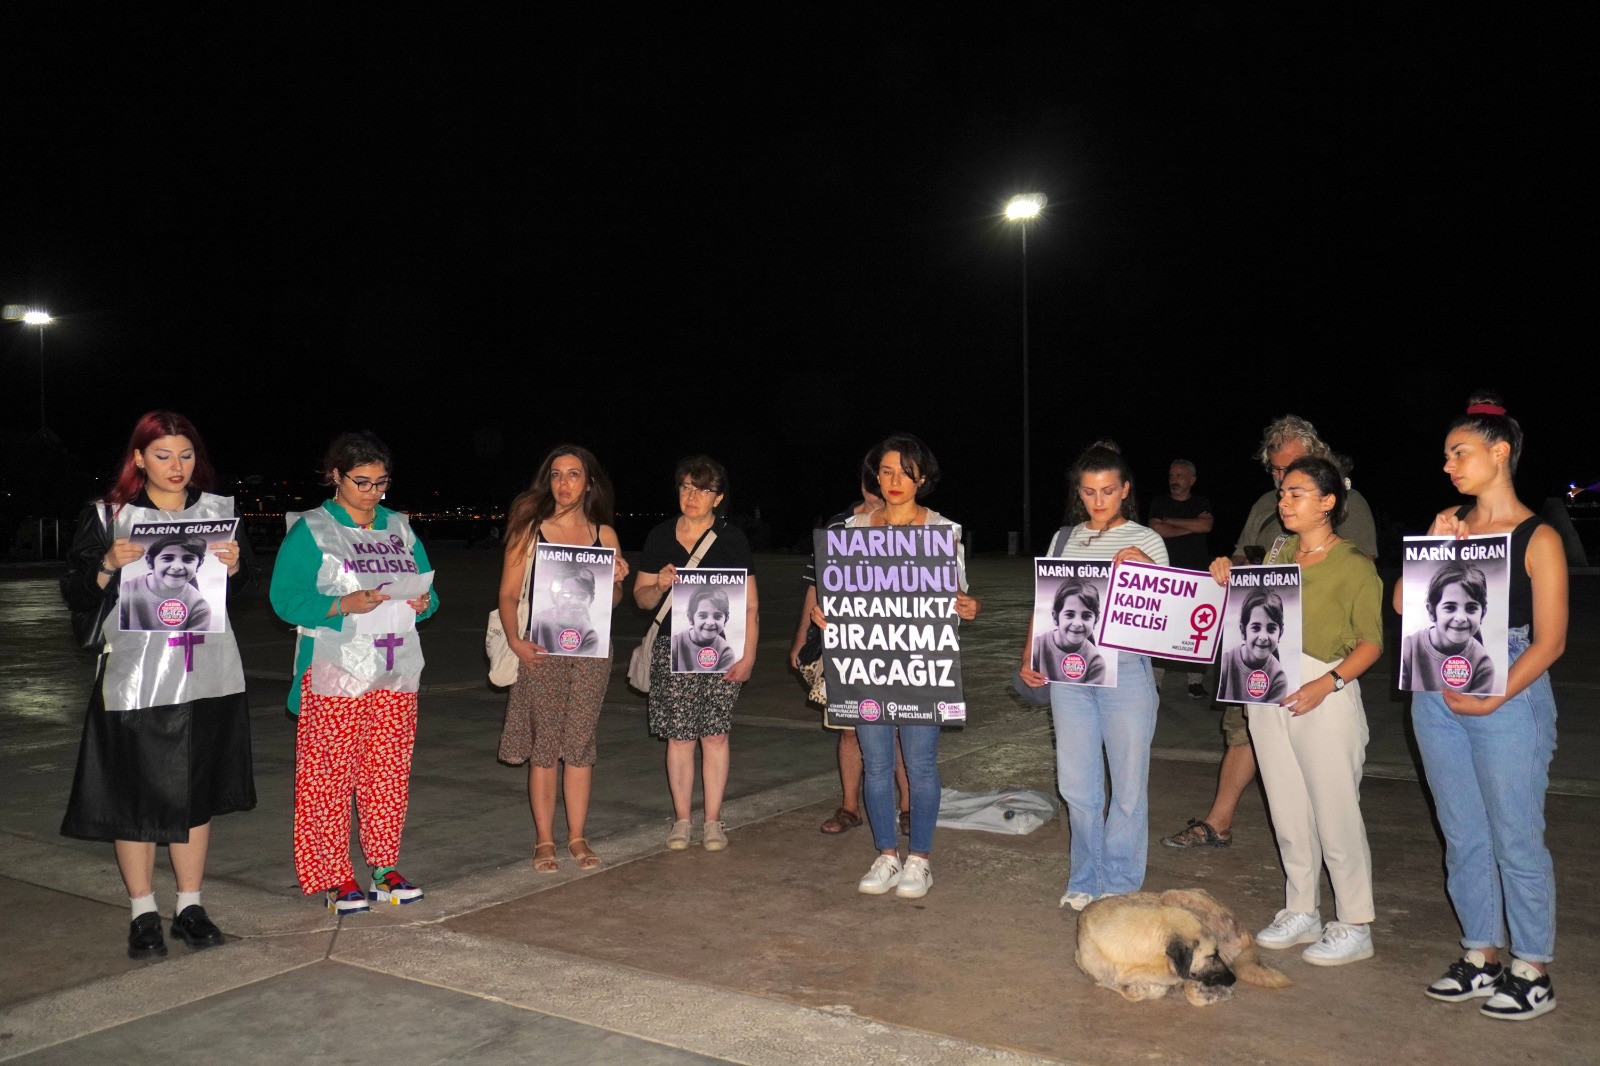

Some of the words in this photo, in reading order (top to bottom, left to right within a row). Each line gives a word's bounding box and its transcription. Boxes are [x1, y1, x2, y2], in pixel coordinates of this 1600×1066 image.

[133, 522, 181, 536] NARİN
[184, 521, 233, 535] GÜRAN
[538, 549, 574, 563] NARİN
[575, 551, 613, 565] GÜRAN
[1405, 544, 1456, 561] NARİN
[1460, 543, 1506, 561] GÜRAN
[709, 573, 744, 585] GÜRAN
[822, 560, 959, 593] ÖLÜMÜNÜ
[1038, 564, 1074, 578] NARİN
[1263, 571, 1299, 586] GÜRAN
[1117, 571, 1198, 599] SAMSUN
[823, 596, 959, 619] KARANLIKTA
[1114, 593, 1161, 613] KADIN
[1110, 610, 1168, 632] MECLİSİ
[823, 625, 959, 651] BIRAKMA
[831, 654, 956, 687] YACAĞIZ
[898, 704, 919, 712] KADIN
[898, 711, 933, 720] MECLİSLERİ
